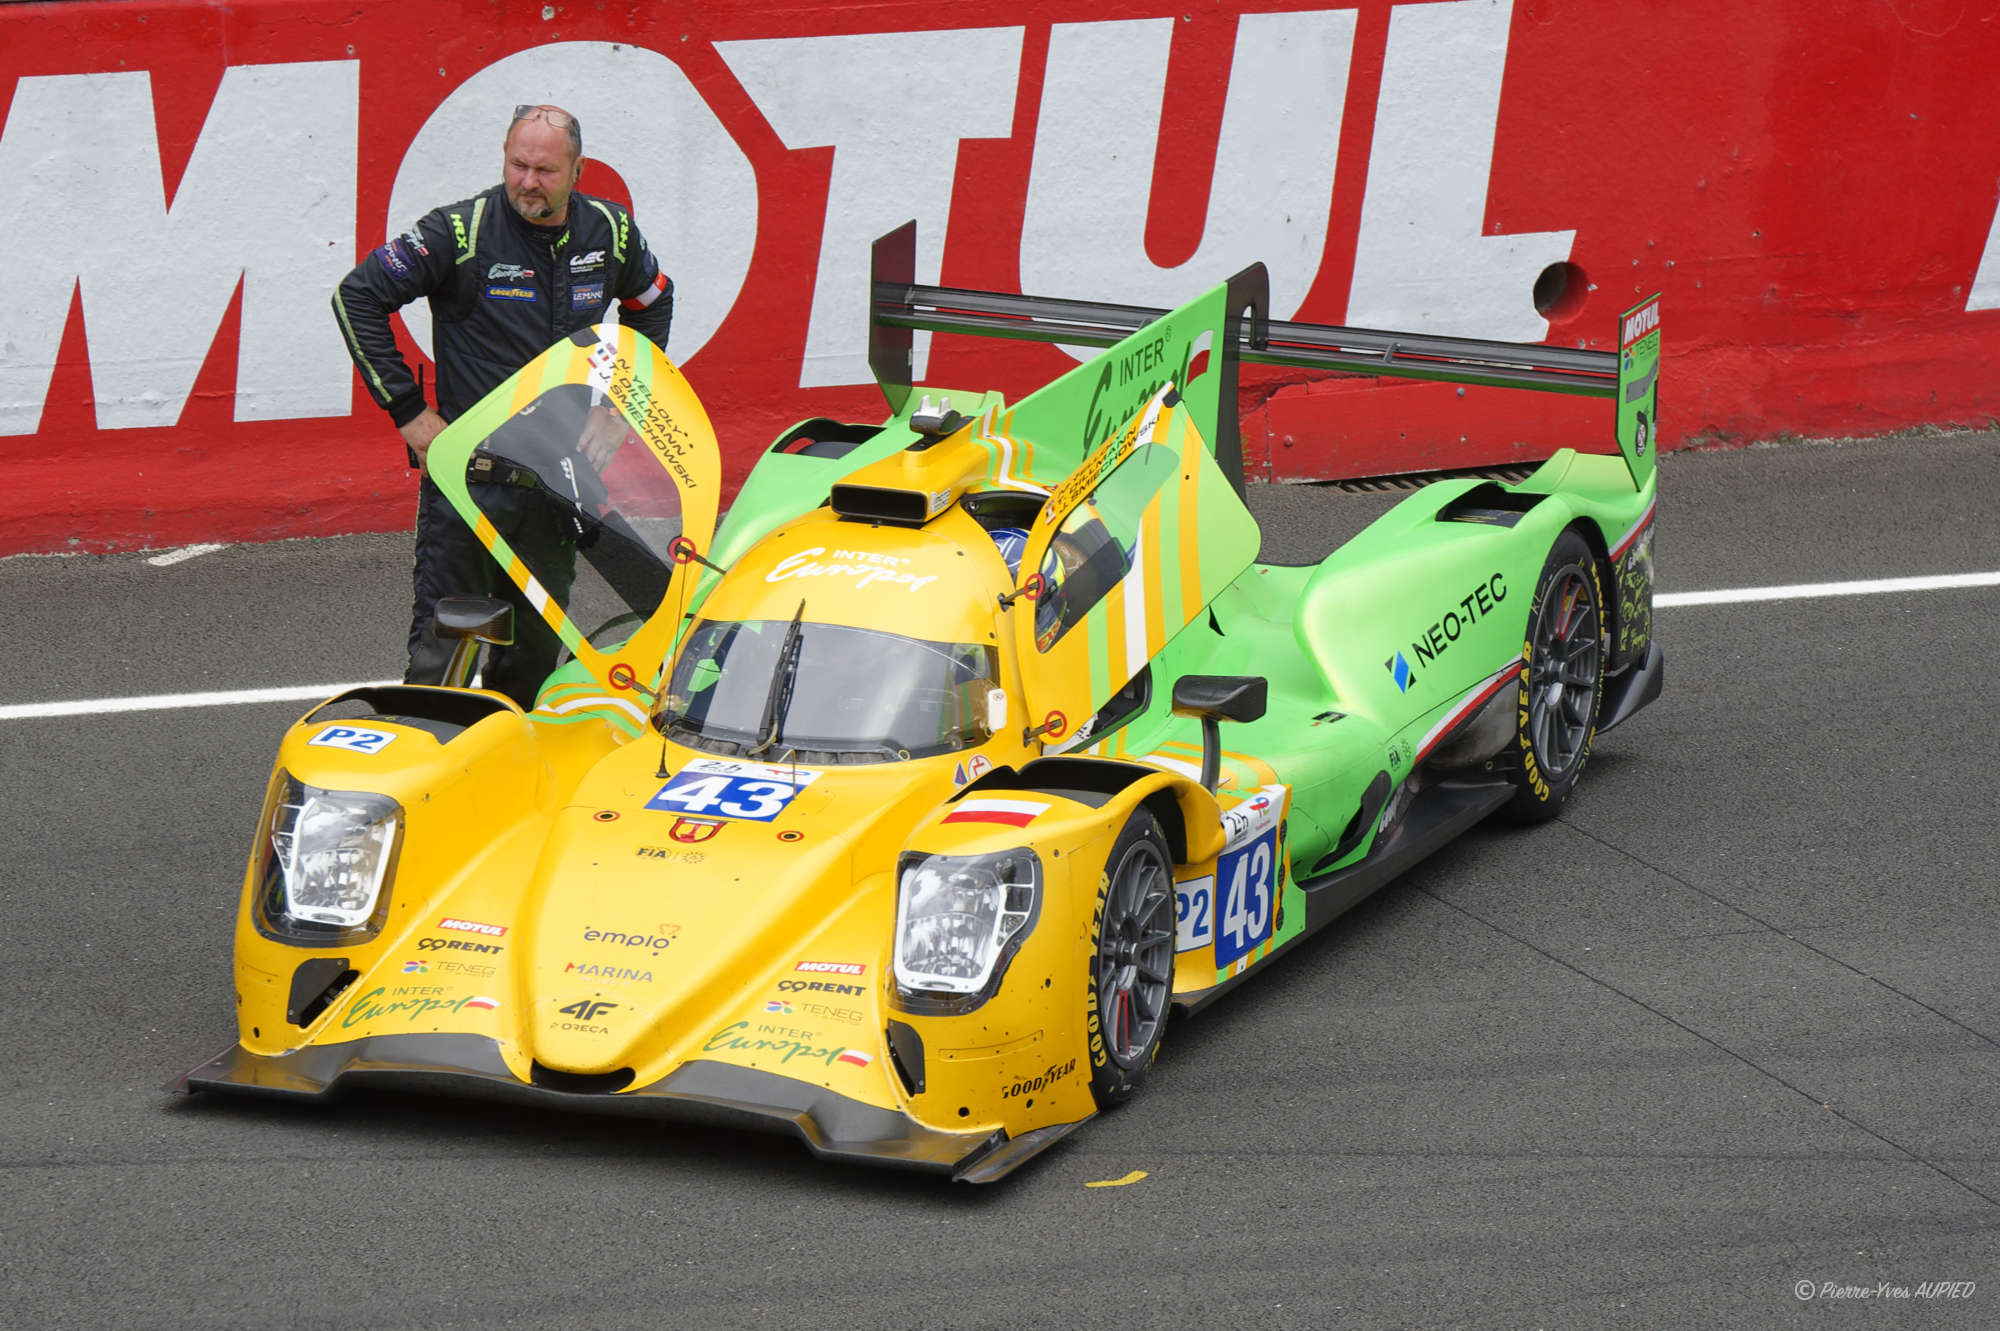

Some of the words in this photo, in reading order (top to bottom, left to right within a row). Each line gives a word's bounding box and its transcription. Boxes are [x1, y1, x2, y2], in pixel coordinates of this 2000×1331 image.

[0, 0, 1576, 437] MOTUL
[570, 251, 606, 266] WEC
[490, 288, 534, 298] GOODYEAR
[1624, 301, 1660, 345] MOTUL
[1120, 338, 1164, 387] INTER
[633, 375, 683, 434] YELLOLY
[619, 377, 686, 456] DILLMANN
[610, 385, 696, 489] SMIECHOWSKI
[832, 550, 899, 566] INTER
[1412, 572, 1507, 669] NEO-TEC
[320, 728, 384, 750] P2
[657, 776, 796, 818] 43
[636, 848, 667, 859] FIA
[1223, 842, 1271, 948] 43
[1177, 888, 1209, 938] P2
[440, 919, 506, 936] MOTUL
[584, 930, 670, 949] emplo
[564, 962, 653, 983] MARINA
[797, 962, 864, 974] MOTUL
[392, 987, 444, 996] INTER
[559, 1000, 619, 1021] 4F
[561, 1023, 609, 1035] ORECA
[758, 1024, 813, 1041] INTER
[1001, 1058, 1076, 1099] GOODYEAR
